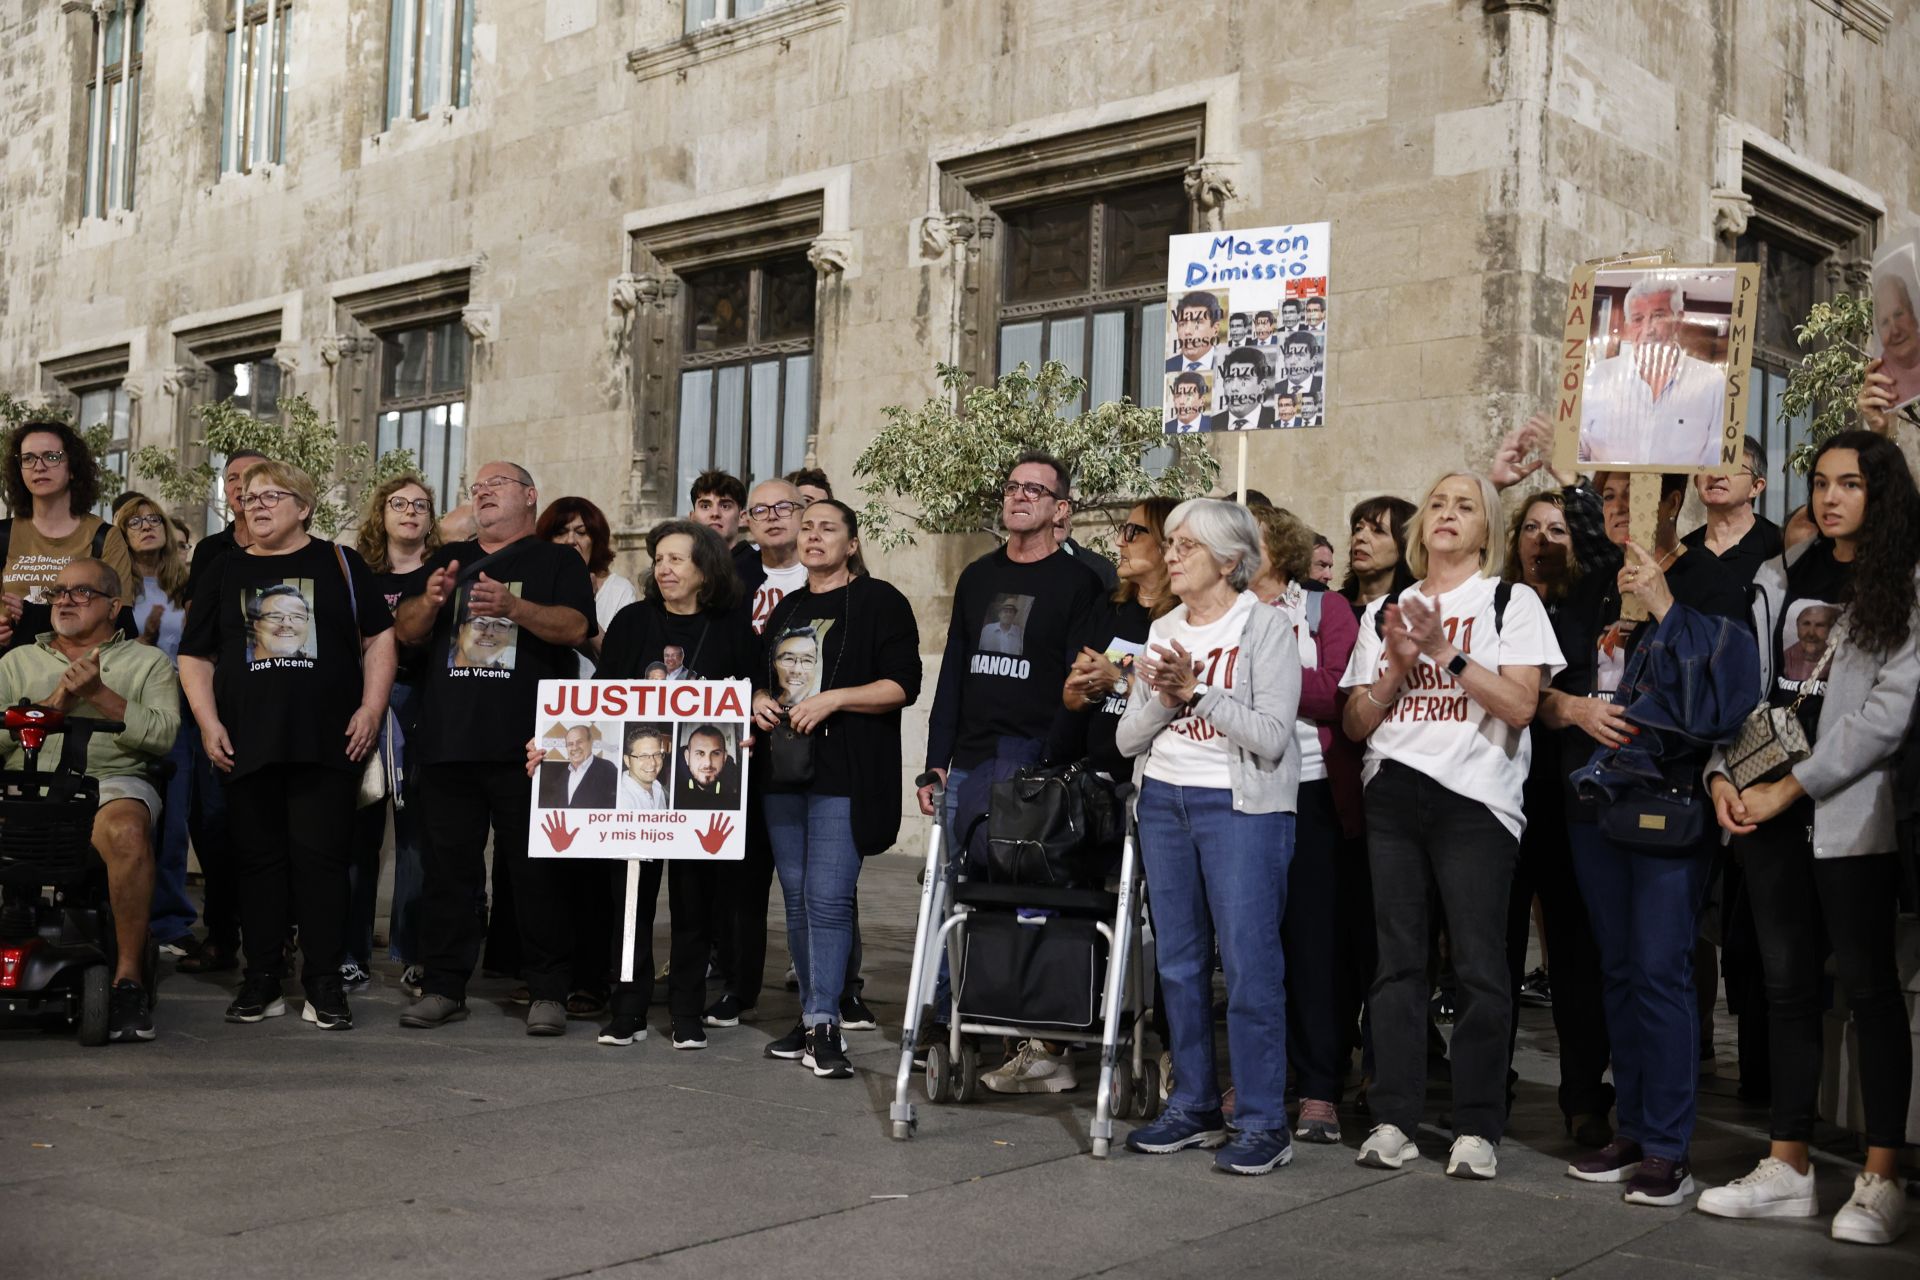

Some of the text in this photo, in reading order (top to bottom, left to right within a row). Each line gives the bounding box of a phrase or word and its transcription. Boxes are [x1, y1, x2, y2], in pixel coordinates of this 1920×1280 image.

[1208, 226, 1309, 260] Mazón
[1185, 253, 1309, 288] Dimissió
[18, 555, 73, 566] 229 fallecid
[20, 564, 66, 572] responsa
[250, 657, 314, 672] José Vicente
[449, 667, 511, 679] José Vicente
[970, 654, 1031, 680] MANOLO
[1206, 646, 1240, 689] 11
[543, 685, 745, 717] JUSTICIA
[1400, 691, 1469, 723] PERDÓ
[588, 811, 687, 824] por mi marido
[599, 829, 674, 843] y mis hijos
